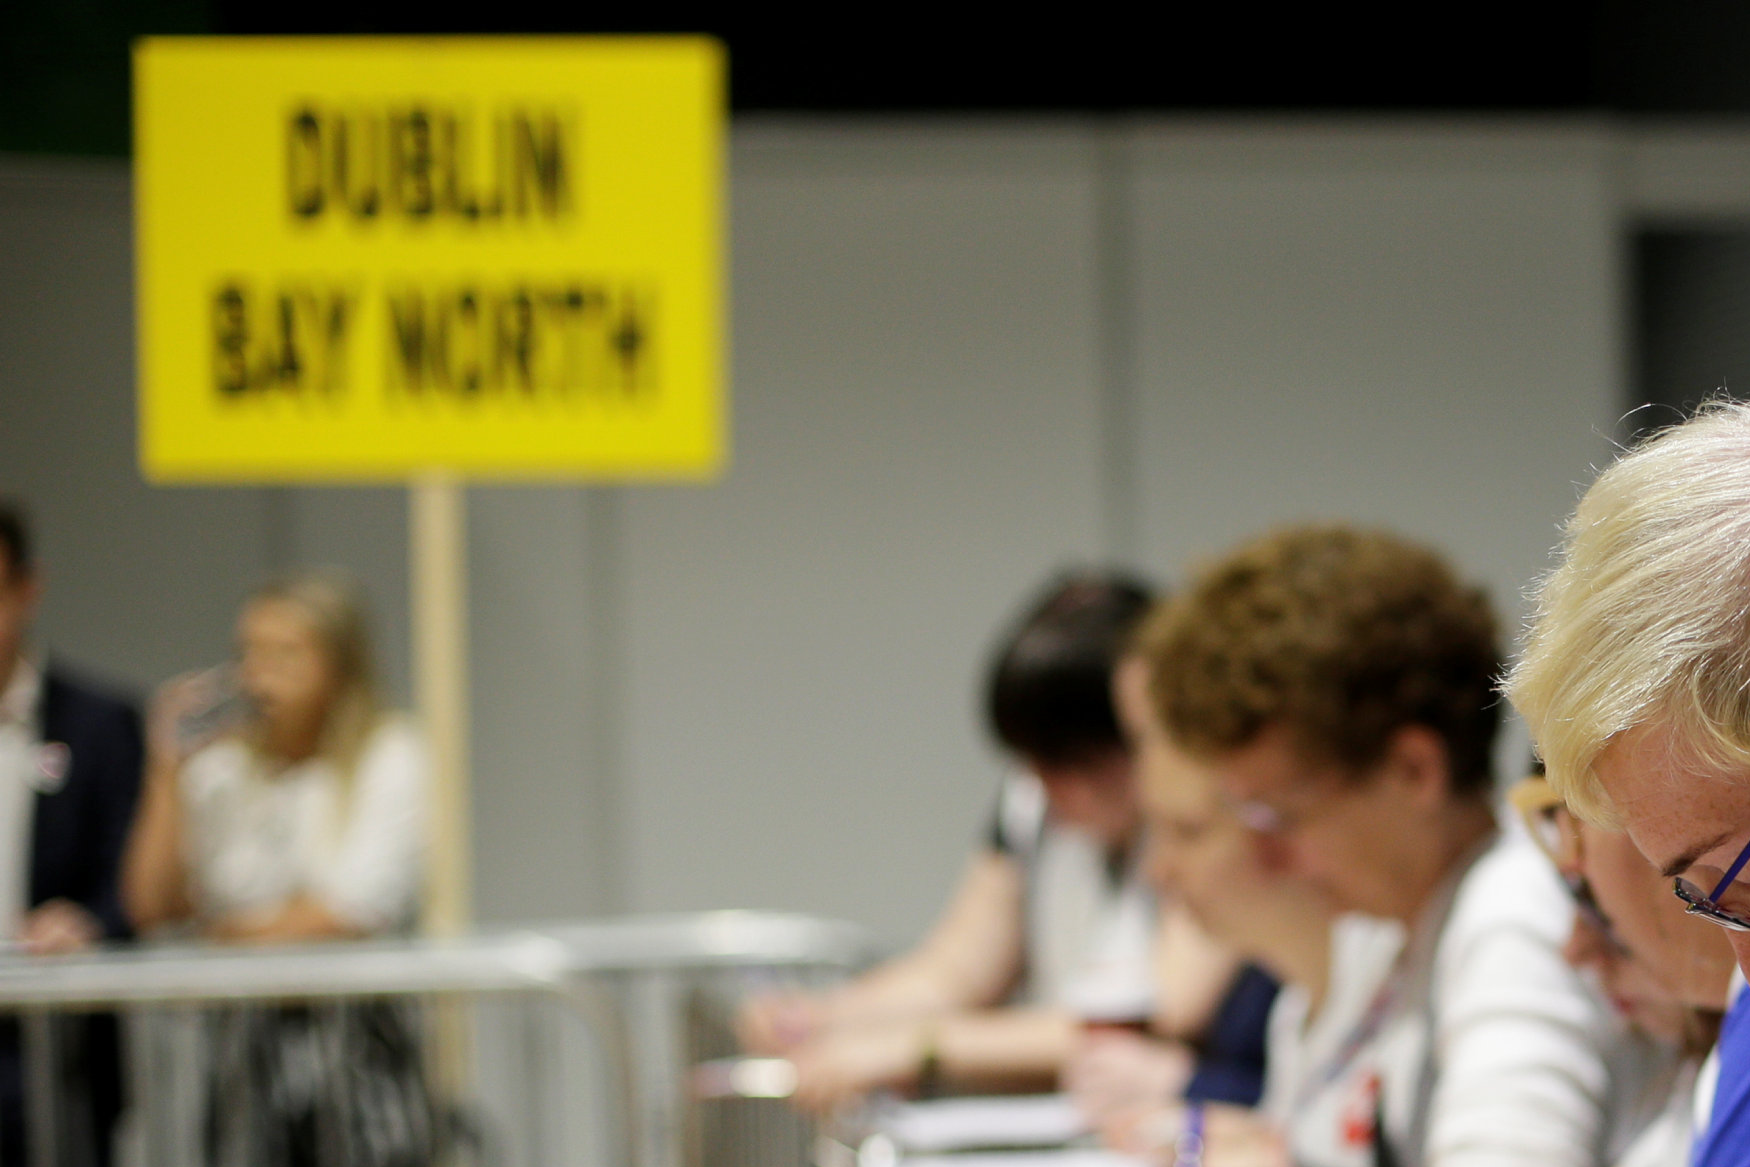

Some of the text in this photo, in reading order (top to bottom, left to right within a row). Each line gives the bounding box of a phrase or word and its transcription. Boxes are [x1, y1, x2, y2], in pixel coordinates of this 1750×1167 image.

[285, 106, 575, 226] DUBLIN
[212, 280, 658, 405] BAY NORTH
